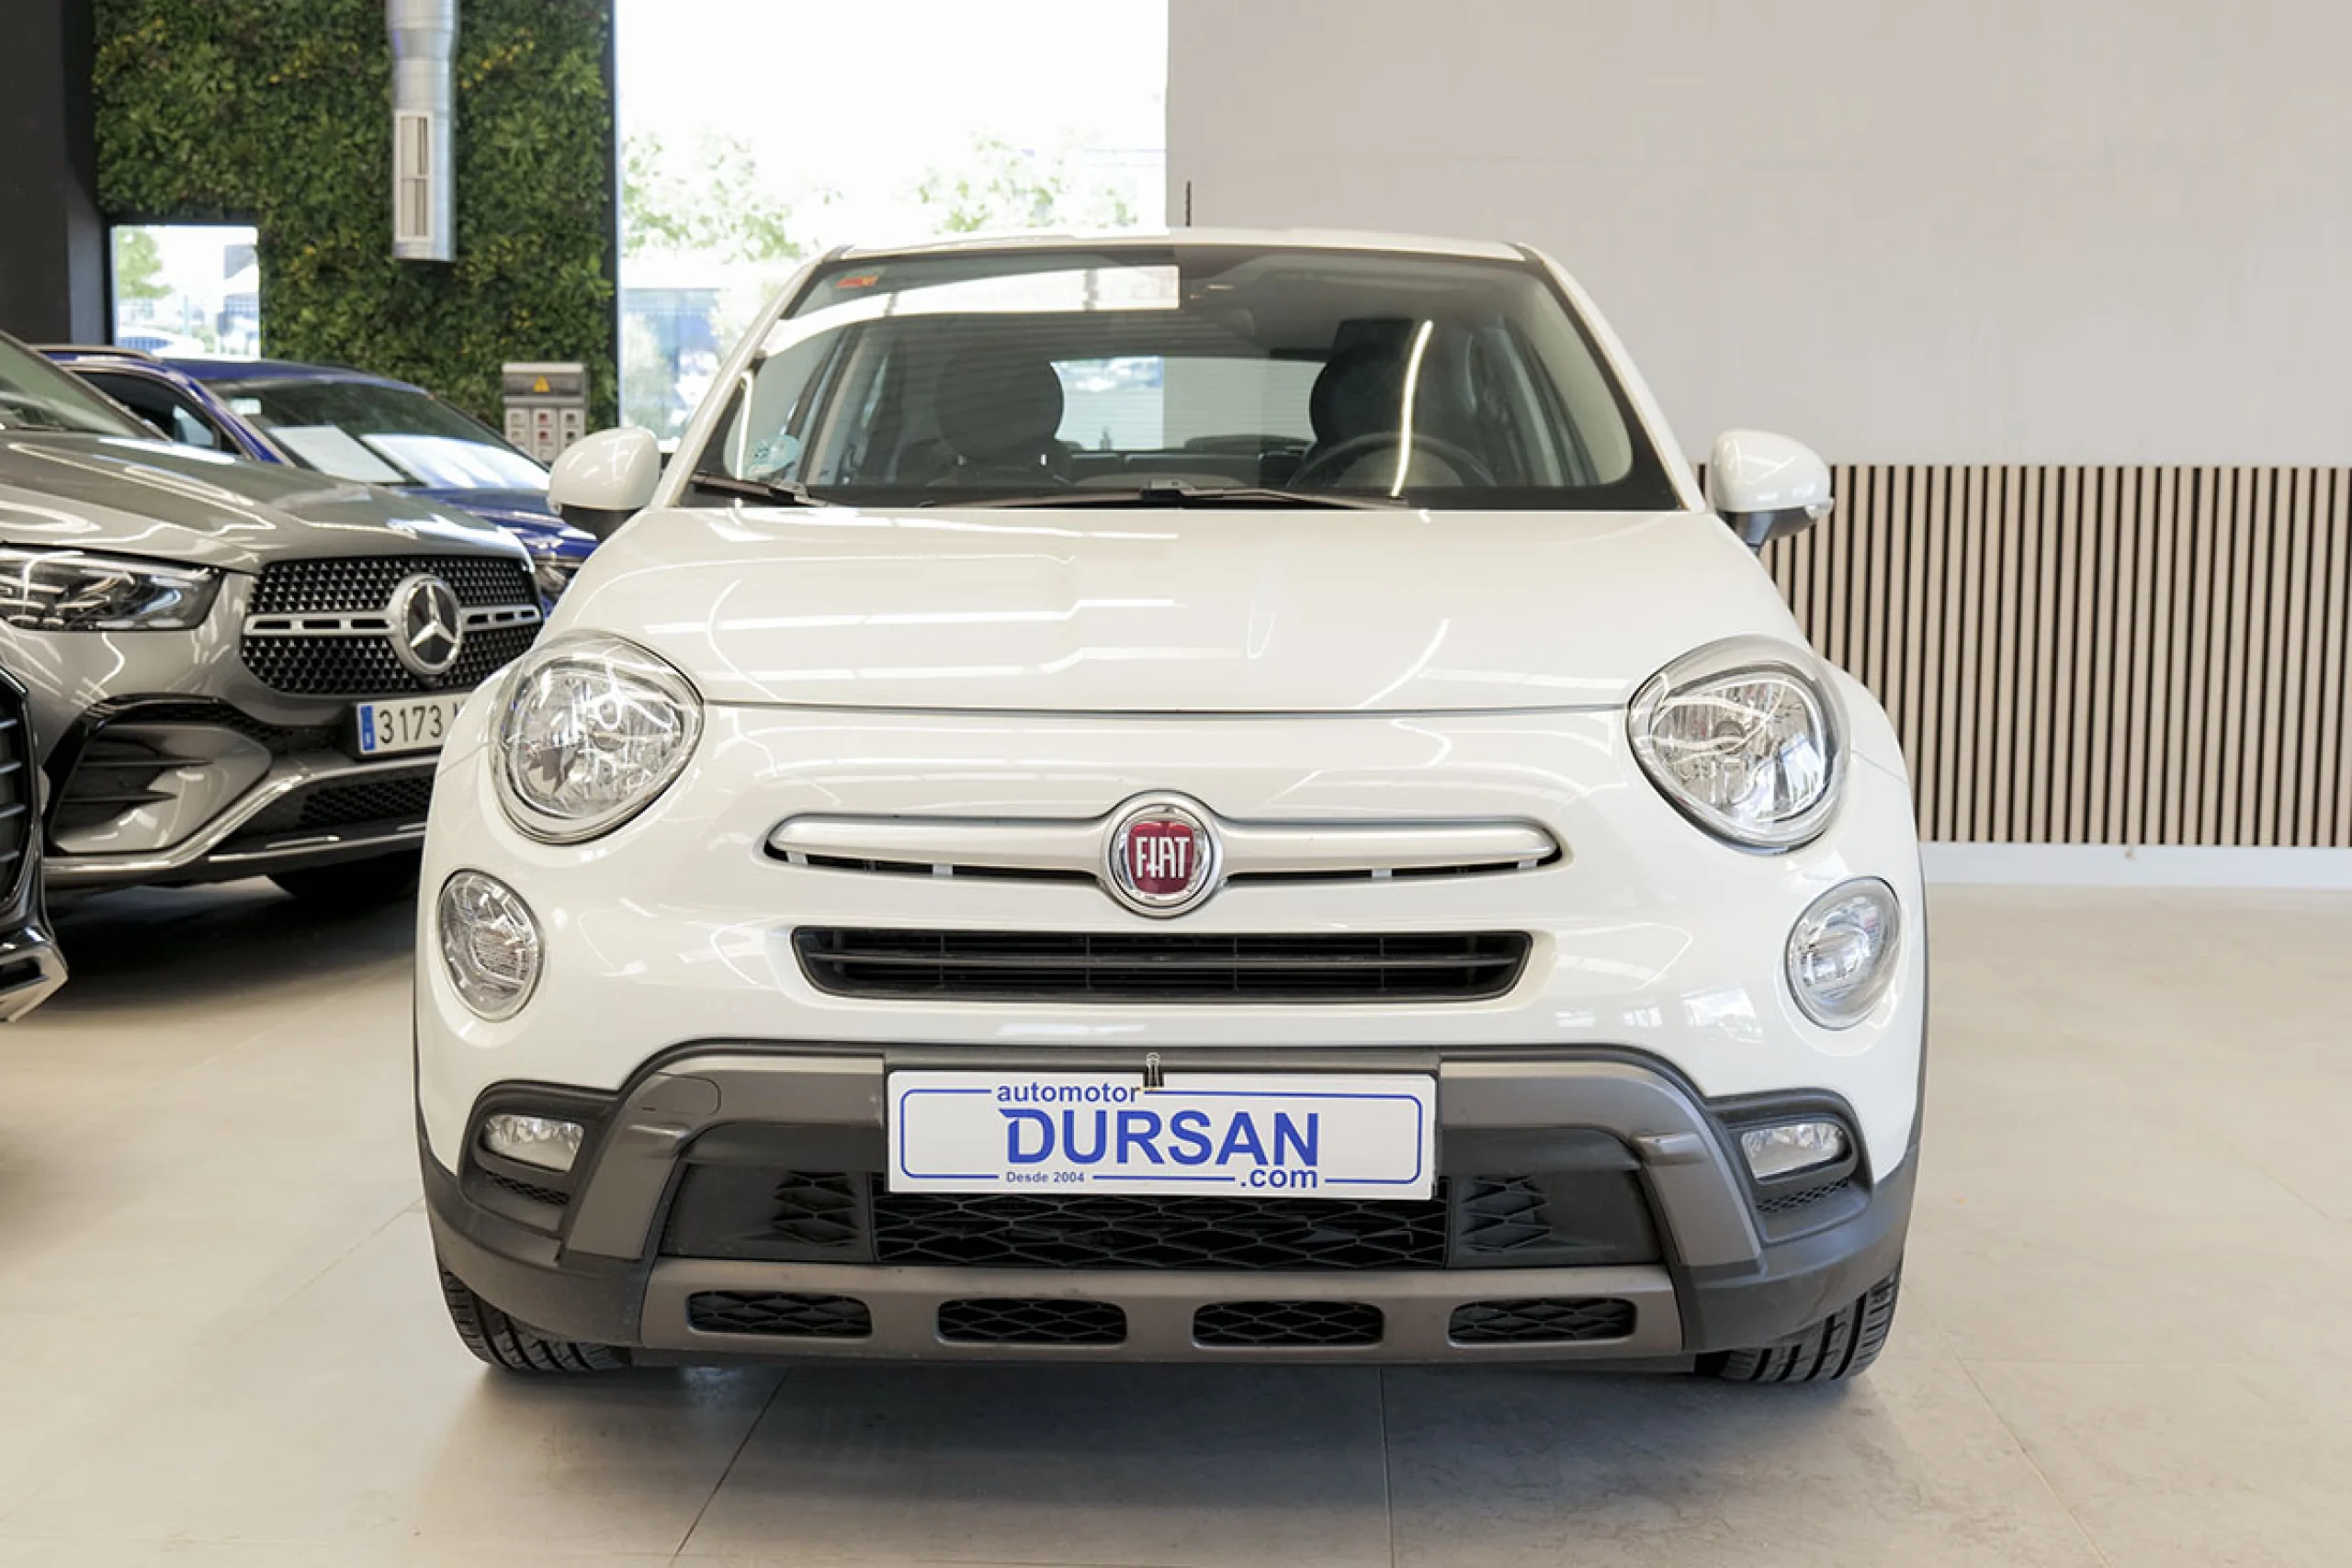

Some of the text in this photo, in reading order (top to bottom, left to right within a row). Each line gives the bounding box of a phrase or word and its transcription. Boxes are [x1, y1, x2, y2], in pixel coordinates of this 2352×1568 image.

[378, 704, 443, 745] 3173
[1136, 837, 1190, 879] FIAT
[997, 1082, 1140, 1103] automotor
[999, 1107, 1319, 1168] DURSAN
[1006, 1171, 1086, 1183] Desde 2004
[1240, 1168, 1319, 1190] .com
